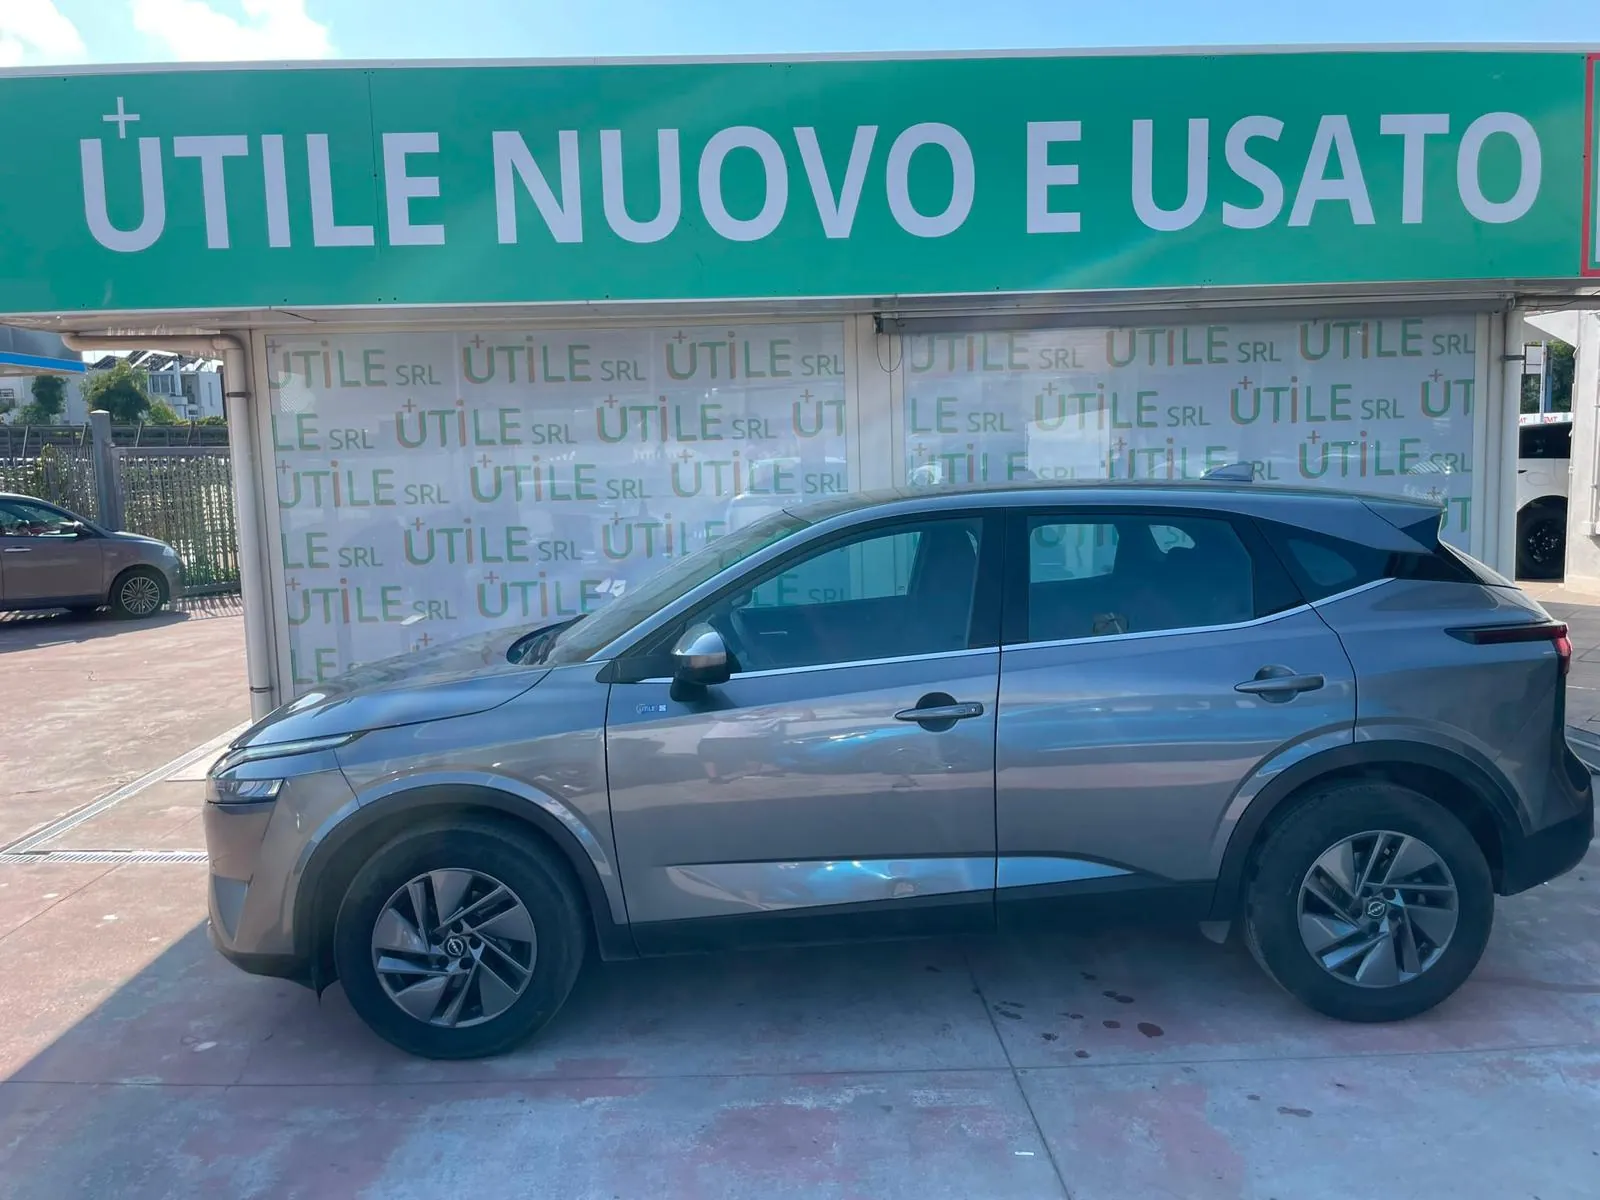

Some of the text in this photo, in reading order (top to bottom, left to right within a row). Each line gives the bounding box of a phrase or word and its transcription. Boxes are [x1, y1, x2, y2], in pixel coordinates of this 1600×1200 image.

[491, 125, 976, 245] NUOVO
[1026, 120, 1082, 234] E
[1131, 111, 1542, 232] USATO
[1237, 342, 1282, 363] SRL
[1432, 334, 1475, 356] SRL
[801, 354, 845, 376] SRL
[1039, 348, 1085, 370] SRL
[395, 364, 442, 386] SRL
[600, 360, 647, 382] SRL
[1167, 406, 1212, 427] SRL
[1360, 399, 1405, 420] SRL
[732, 419, 777, 440] SRL
[967, 412, 1013, 433] SRL
[329, 429, 375, 450] SRL
[532, 423, 578, 445] SRL
[1252, 461, 1280, 480] RL
[1430, 453, 1473, 474] SRL
[404, 484, 450, 505] SRL
[606, 479, 652, 500] SRL
[804, 473, 848, 495] SRL
[338, 547, 384, 568] SRL
[538, 540, 582, 562] SRL
[412, 600, 457, 620] SRL
